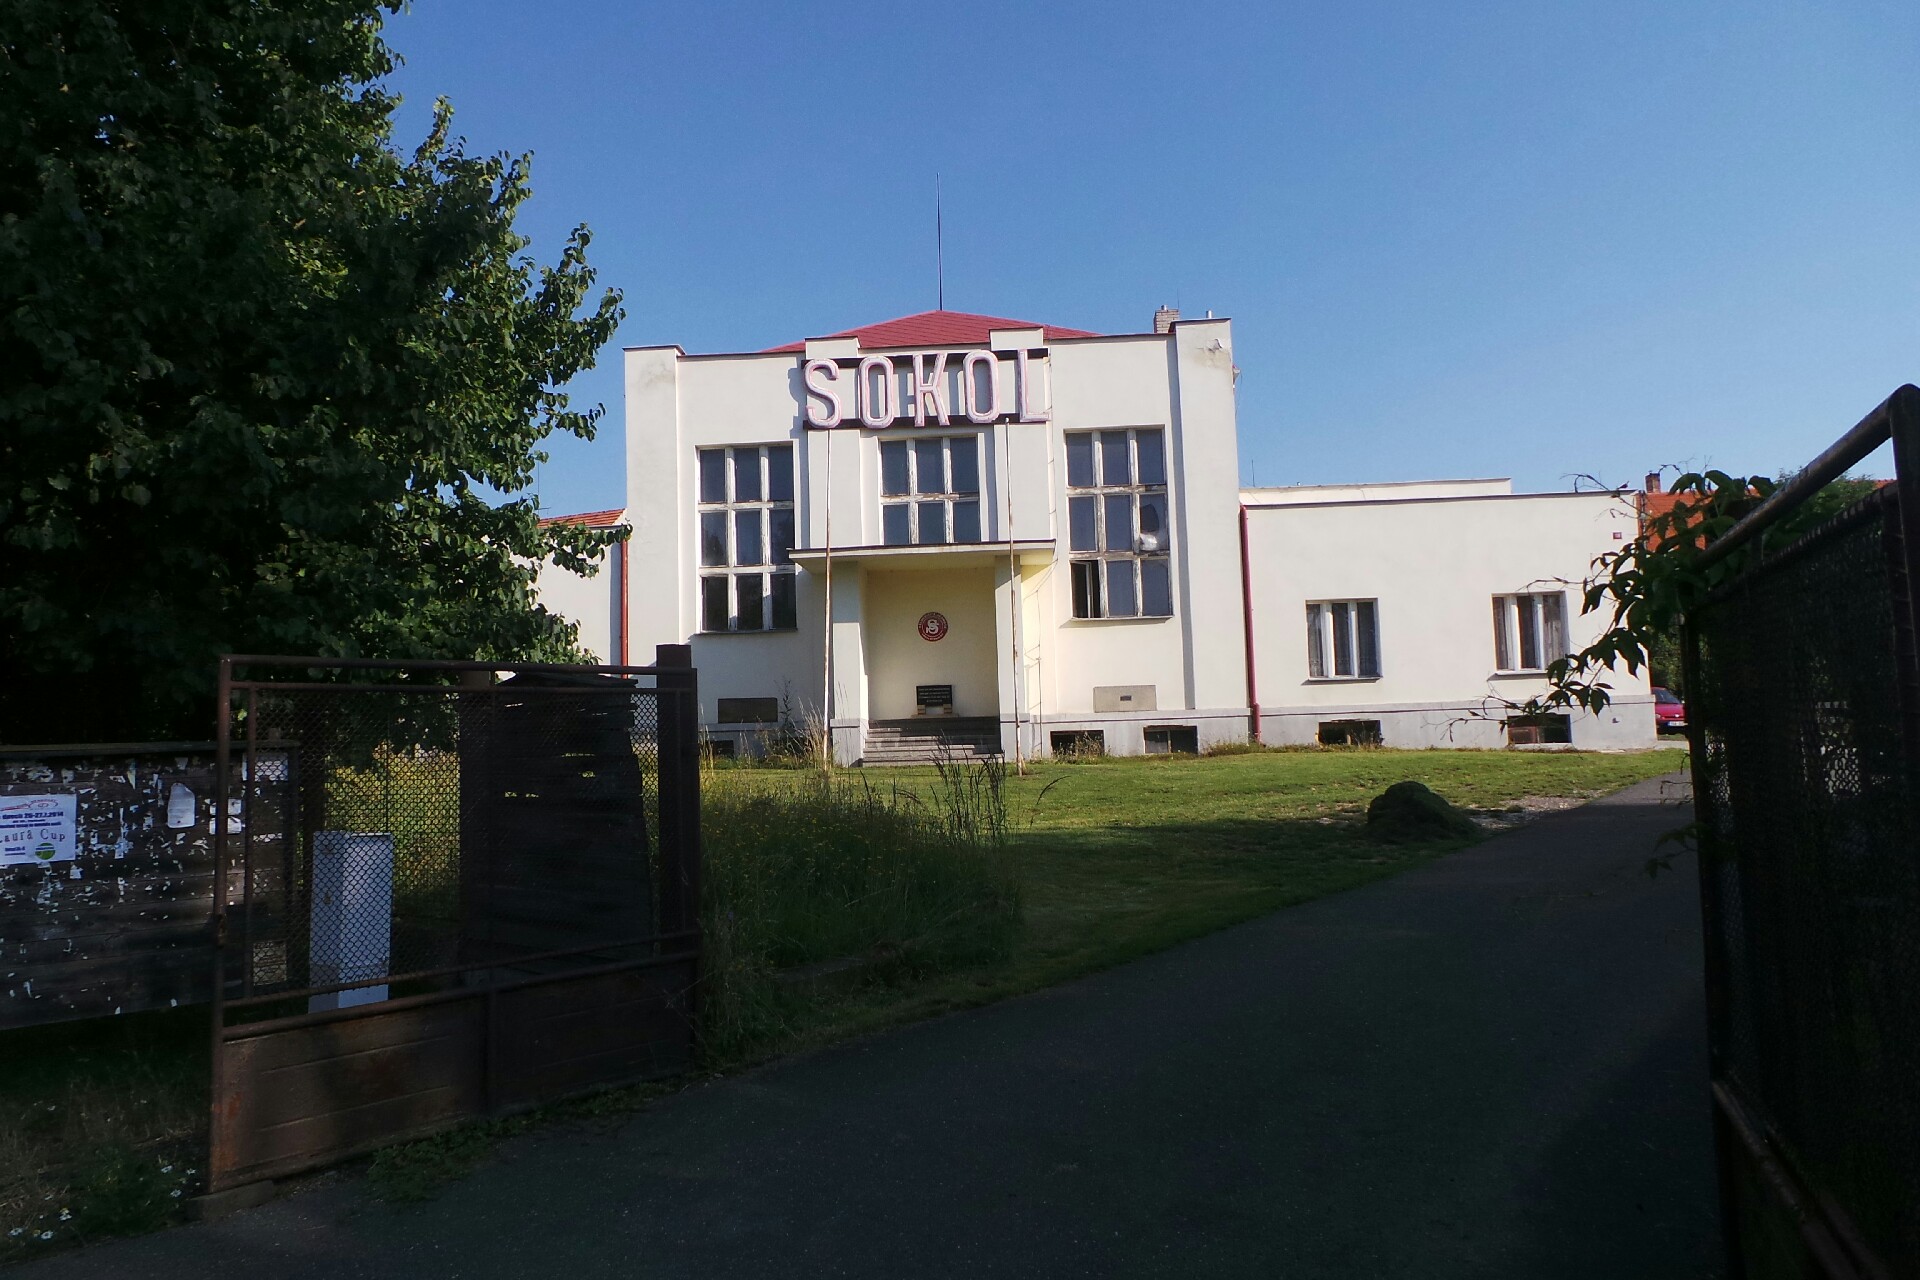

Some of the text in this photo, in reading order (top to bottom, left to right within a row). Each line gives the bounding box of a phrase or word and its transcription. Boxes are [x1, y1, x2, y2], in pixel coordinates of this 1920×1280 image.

[804, 349, 1050, 429] SOKOL
[0, 828, 66, 843] aura Cup
